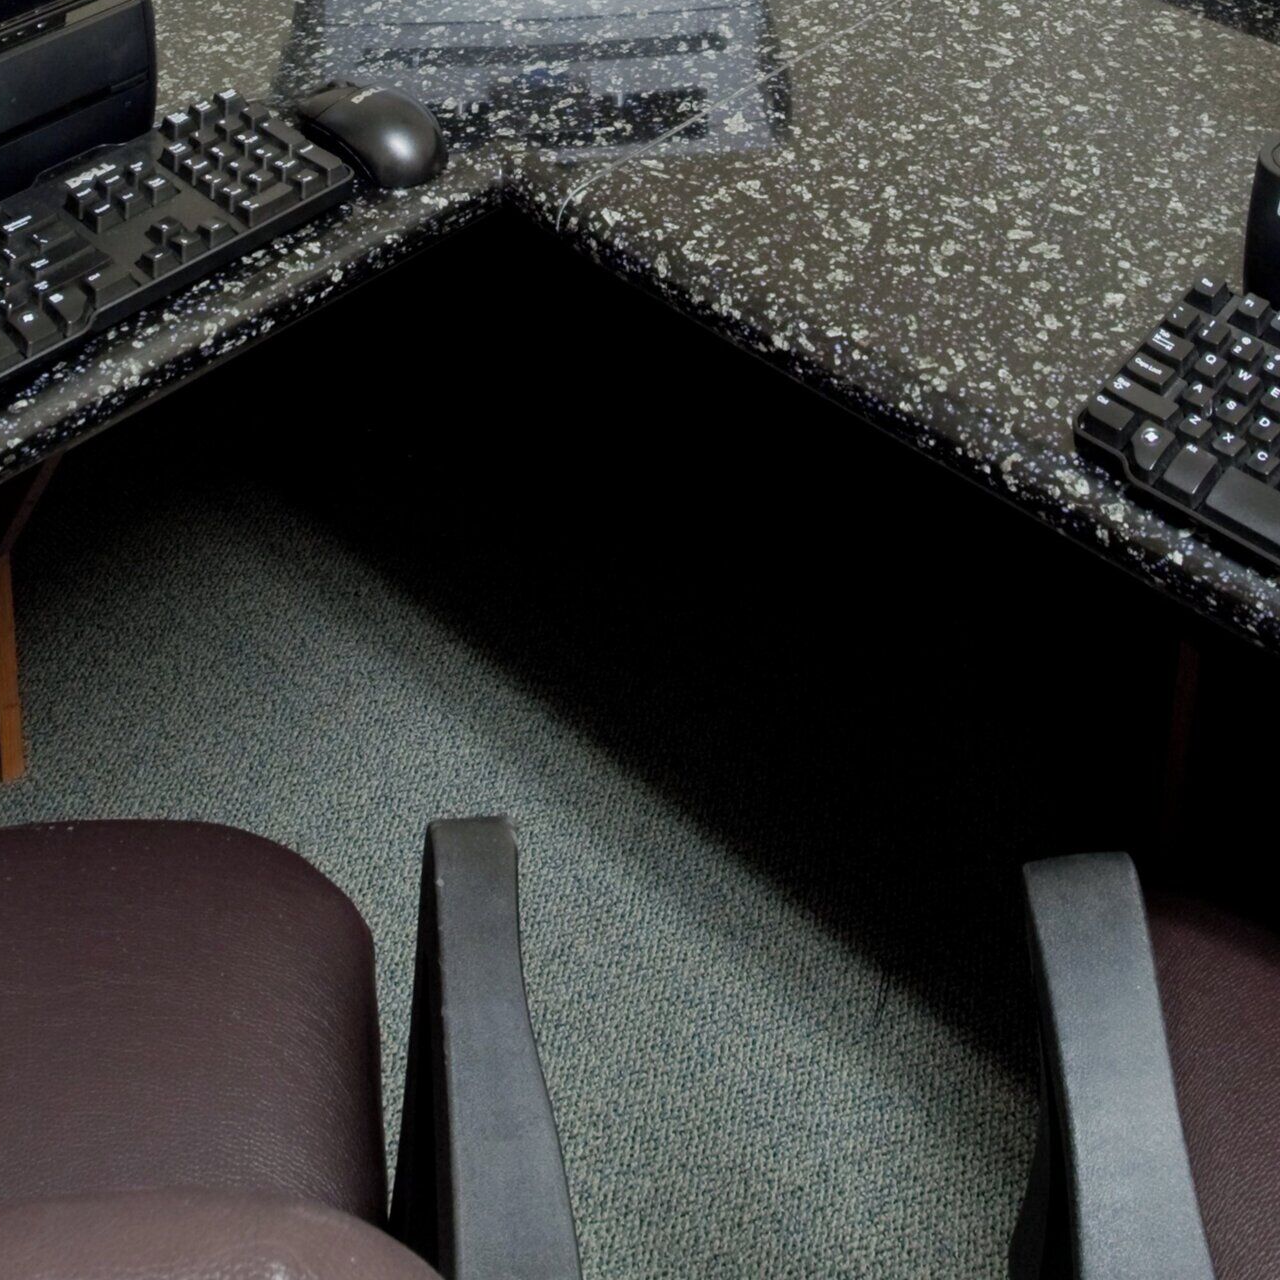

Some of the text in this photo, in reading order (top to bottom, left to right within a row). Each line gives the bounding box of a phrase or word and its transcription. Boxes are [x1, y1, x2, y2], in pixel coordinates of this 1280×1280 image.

[65, 163, 116, 189] DELL
[1232, 344, 1243, 354] 2
[1205, 354, 1217, 365] Q
[1266, 361, 1275, 371] 3
[1238, 369, 1253, 382] W
[1193, 383, 1204, 394] A
[1225, 399, 1238, 411] S
[1188, 414, 1203, 425] Z
[1258, 417, 1271, 428] D
[1222, 431, 1236, 444] X
[1256, 451, 1269, 461] C
